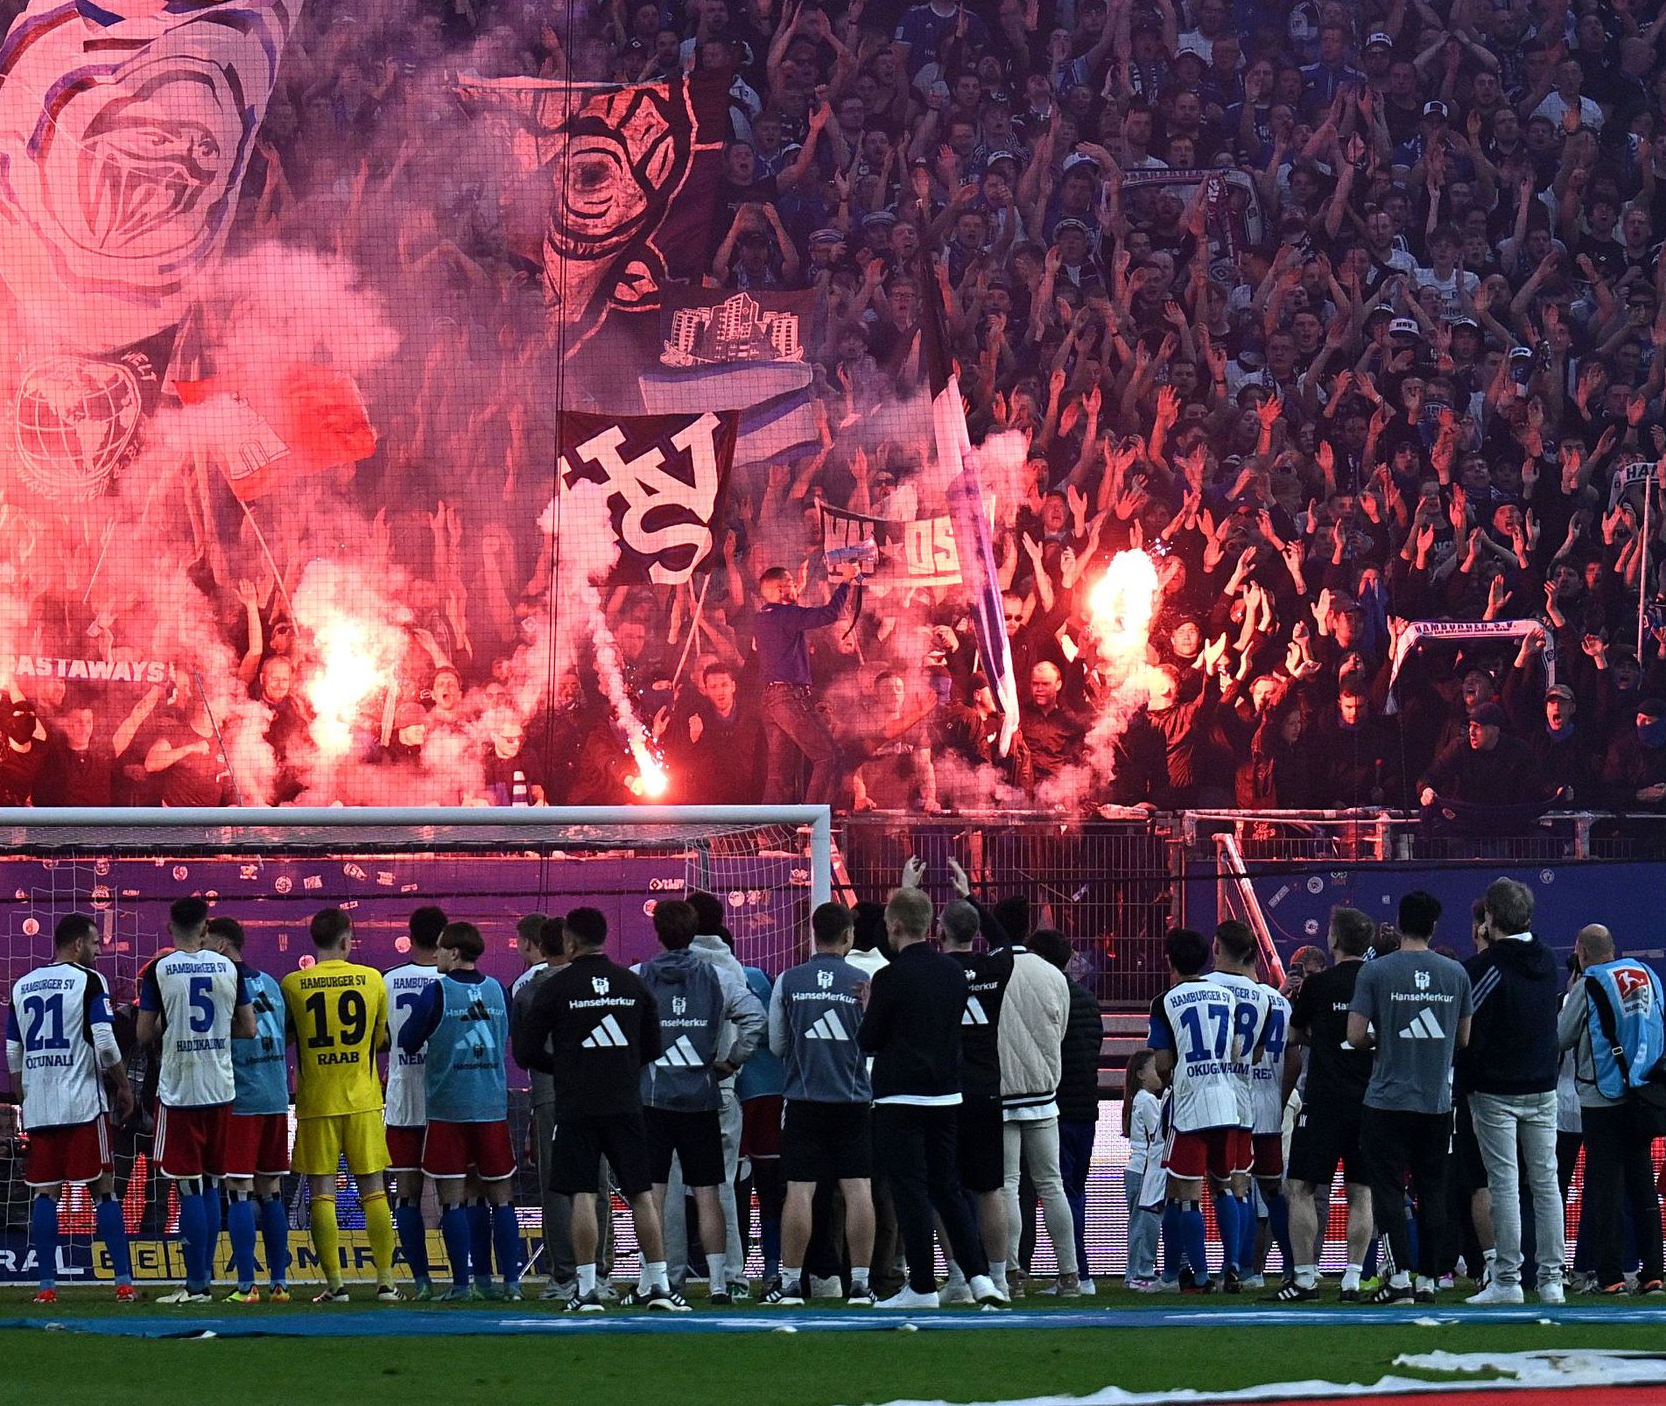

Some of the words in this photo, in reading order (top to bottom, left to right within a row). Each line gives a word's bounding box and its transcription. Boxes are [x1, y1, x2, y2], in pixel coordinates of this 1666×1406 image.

[15, 656, 165, 684] ASTAWAYS
[165, 962, 215, 975] HAMBURGER
[216, 961, 228, 974] SV
[20, 980, 63, 994] HAMBURGER
[63, 978, 75, 991] SV
[299, 974, 355, 990] HAMBURGER
[355, 974, 367, 986] SV
[189, 976, 215, 1033] 5
[569, 996, 636, 1010] HanseMerkur
[791, 990, 858, 1005] HanseMerkur
[1169, 989, 1222, 1008] HAMBURGER
[1222, 991, 1232, 1004] SV
[1252, 992, 1261, 1003] SV
[1389, 991, 1454, 1004] HanseMerkur
[22, 993, 72, 1053] 21
[304, 989, 368, 1049] 19
[1179, 1004, 1231, 1063] 17
[317, 1052, 360, 1066] RAAB
